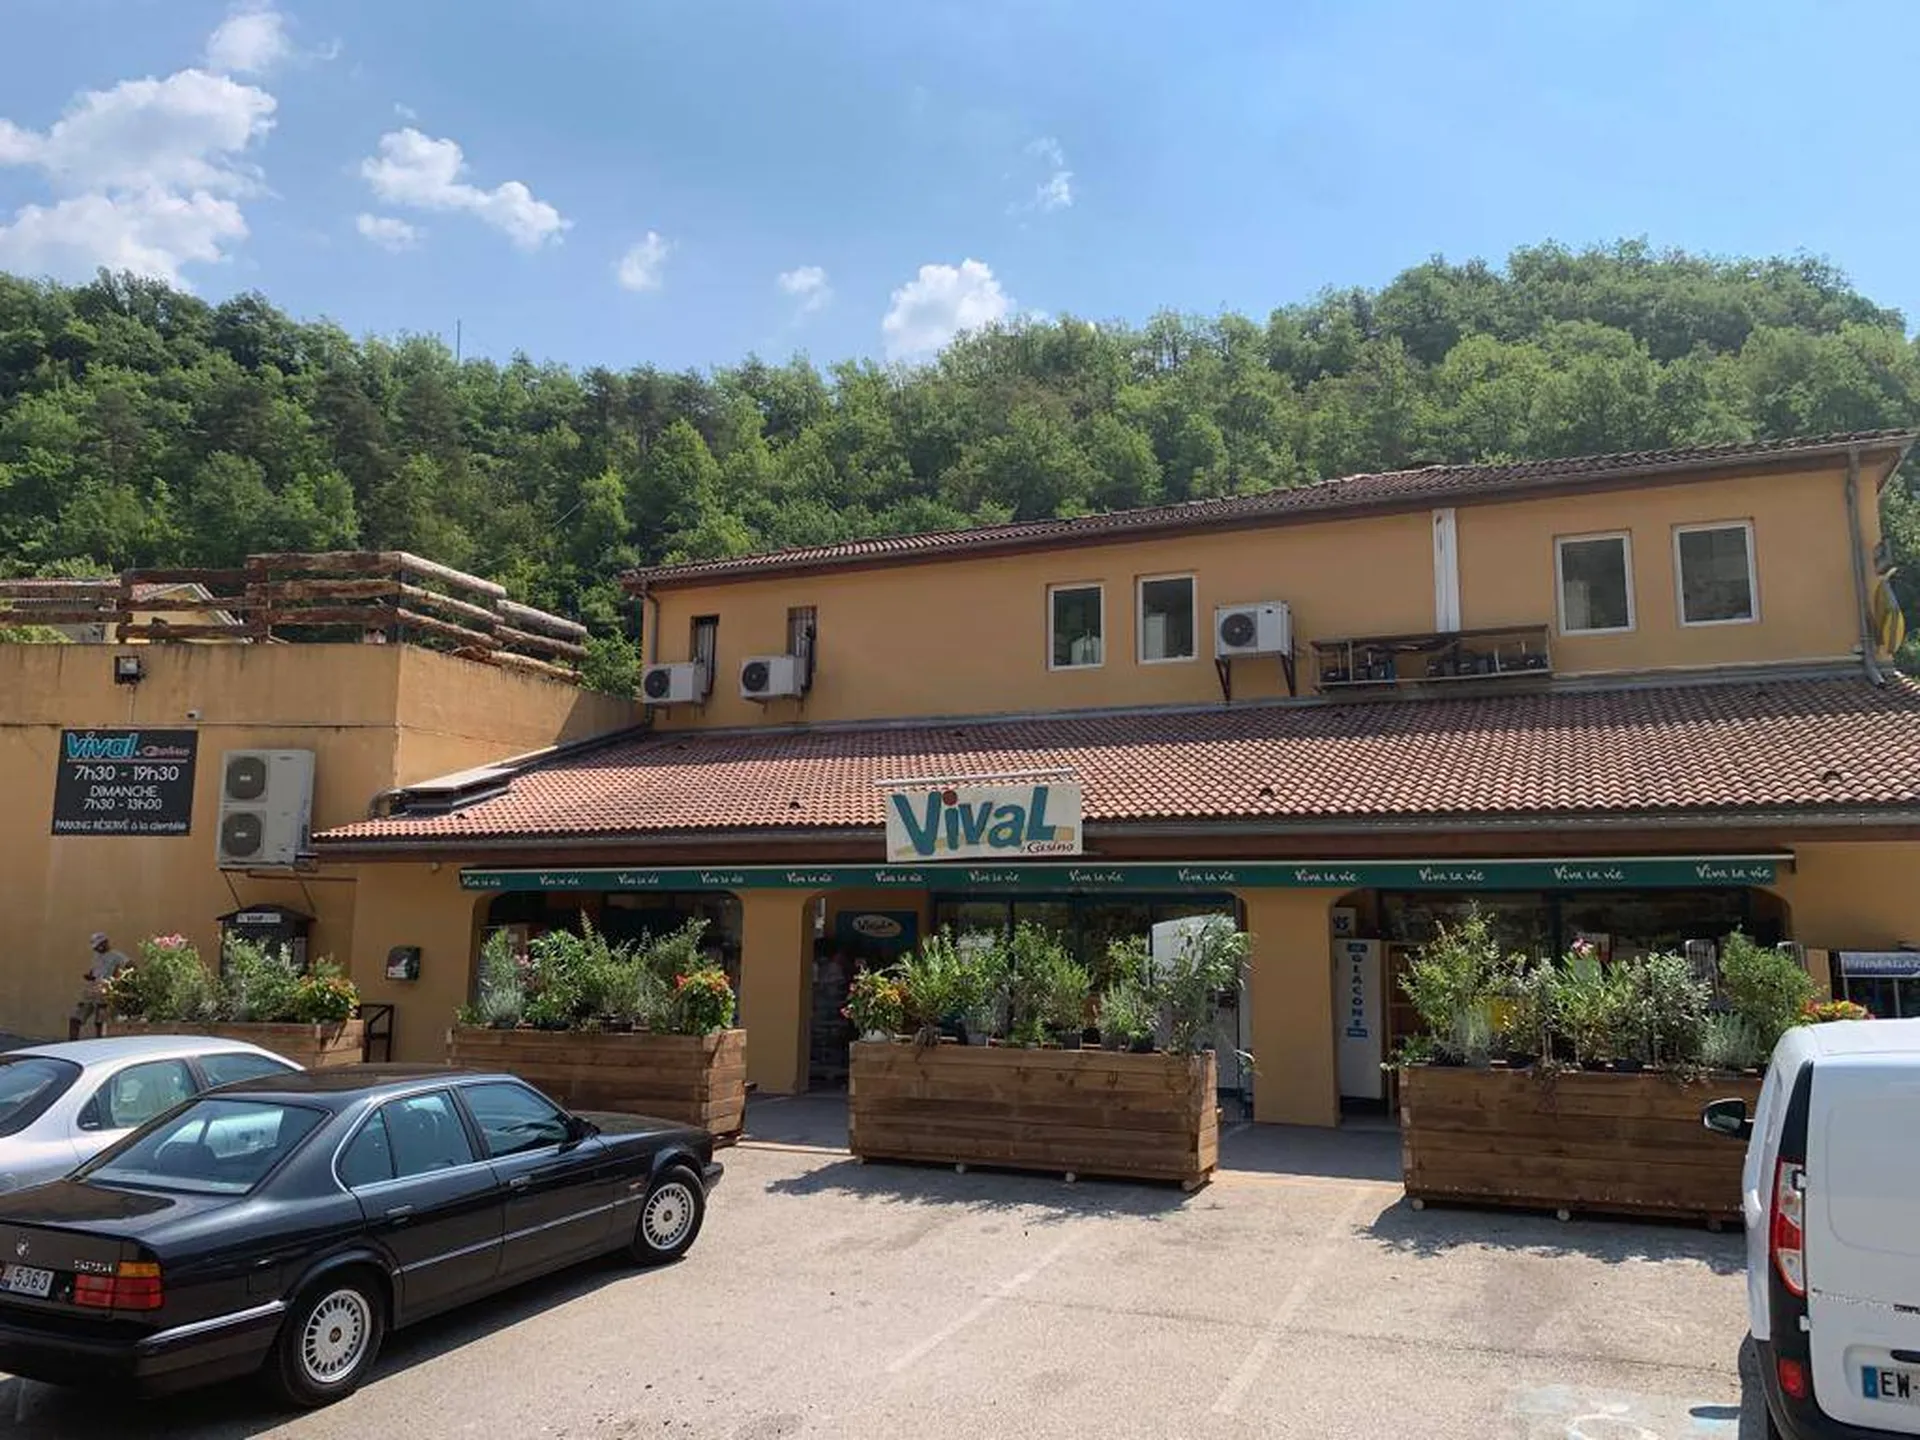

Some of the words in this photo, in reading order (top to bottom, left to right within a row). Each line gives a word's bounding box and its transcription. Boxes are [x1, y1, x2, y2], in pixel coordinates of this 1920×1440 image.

[74, 765, 116, 781] 7h30
[133, 765, 179, 781] 19h30
[90, 785, 158, 797] DIMANCHE
[1553, 865, 1583, 880] Viva
[1603, 867, 1624, 880] vie
[1696, 863, 1727, 880] Viva
[1750, 866, 1772, 880] vie
[15, 1268, 49, 1291] 5363
